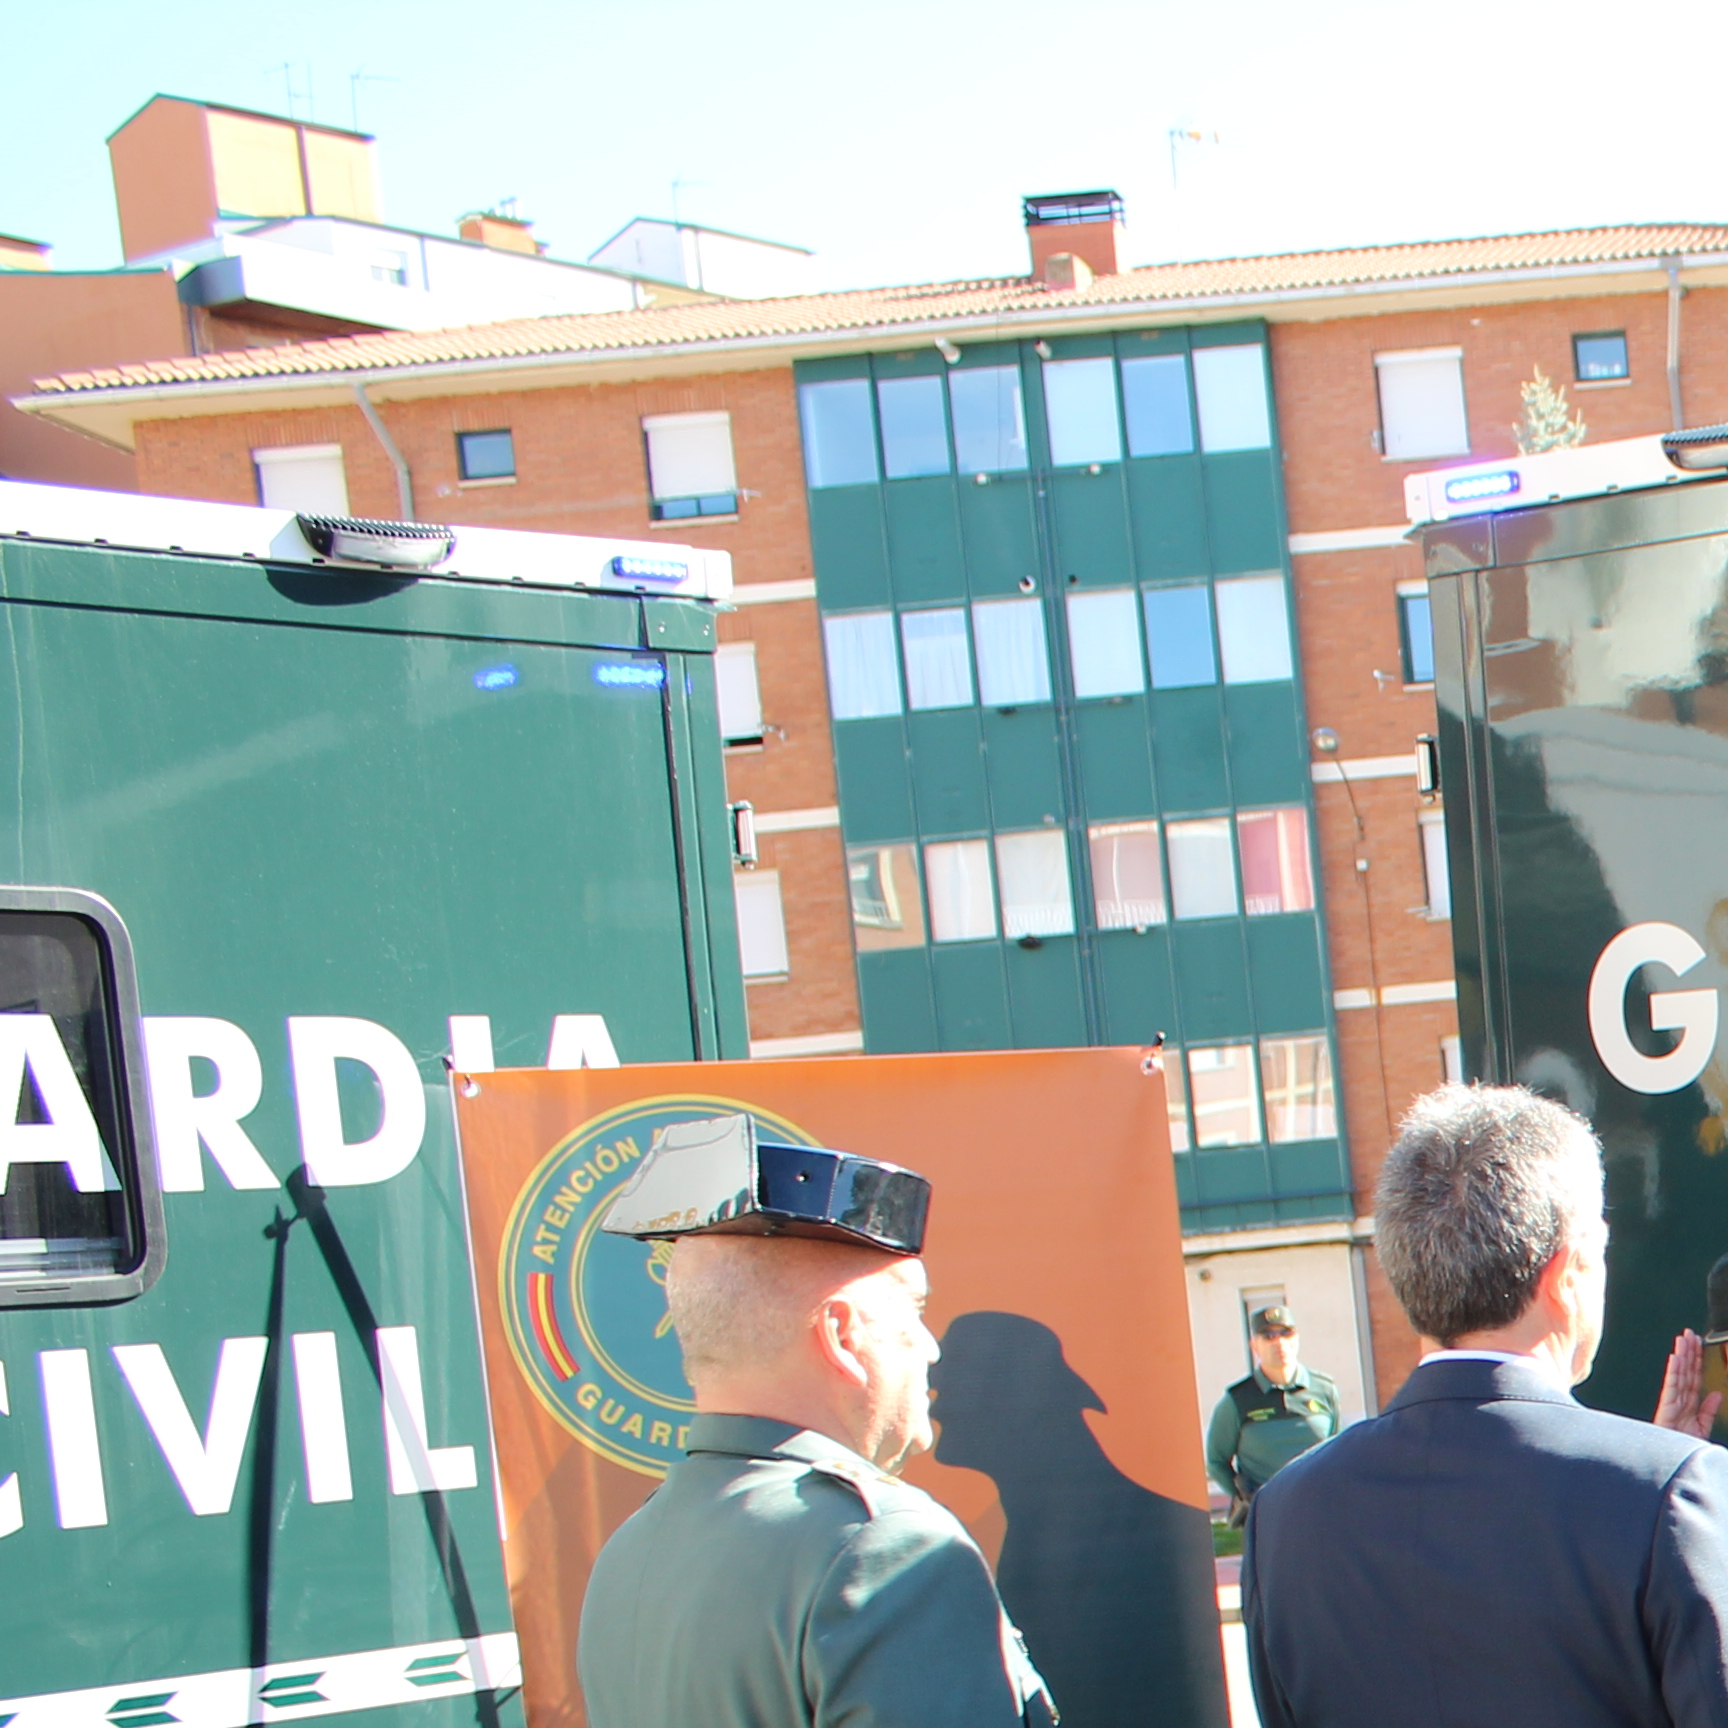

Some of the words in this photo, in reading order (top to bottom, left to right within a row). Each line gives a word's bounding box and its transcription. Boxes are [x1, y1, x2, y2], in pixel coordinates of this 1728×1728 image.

[0, 1014, 621, 1193] ARD
[531, 1136, 641, 1265] ATENCIÓN
[0, 1326, 478, 1539] IVIL
